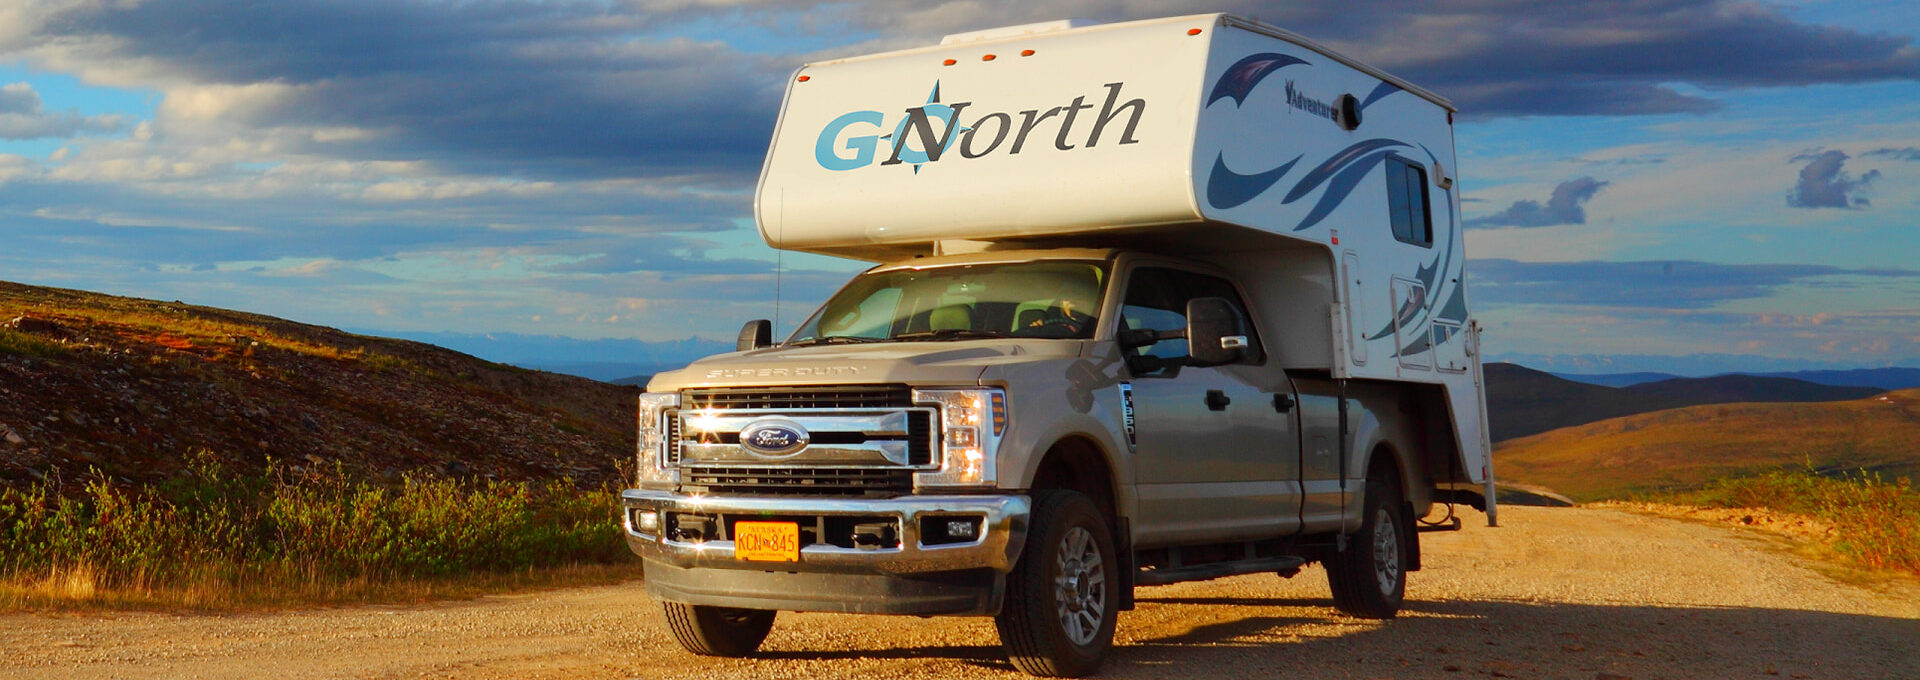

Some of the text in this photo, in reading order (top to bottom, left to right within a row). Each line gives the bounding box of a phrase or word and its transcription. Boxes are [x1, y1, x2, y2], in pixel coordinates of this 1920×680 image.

[706, 366, 860, 378] SUPER DUTY
[756, 430, 789, 445] Ford
[738, 533, 795, 552] KCN 845
